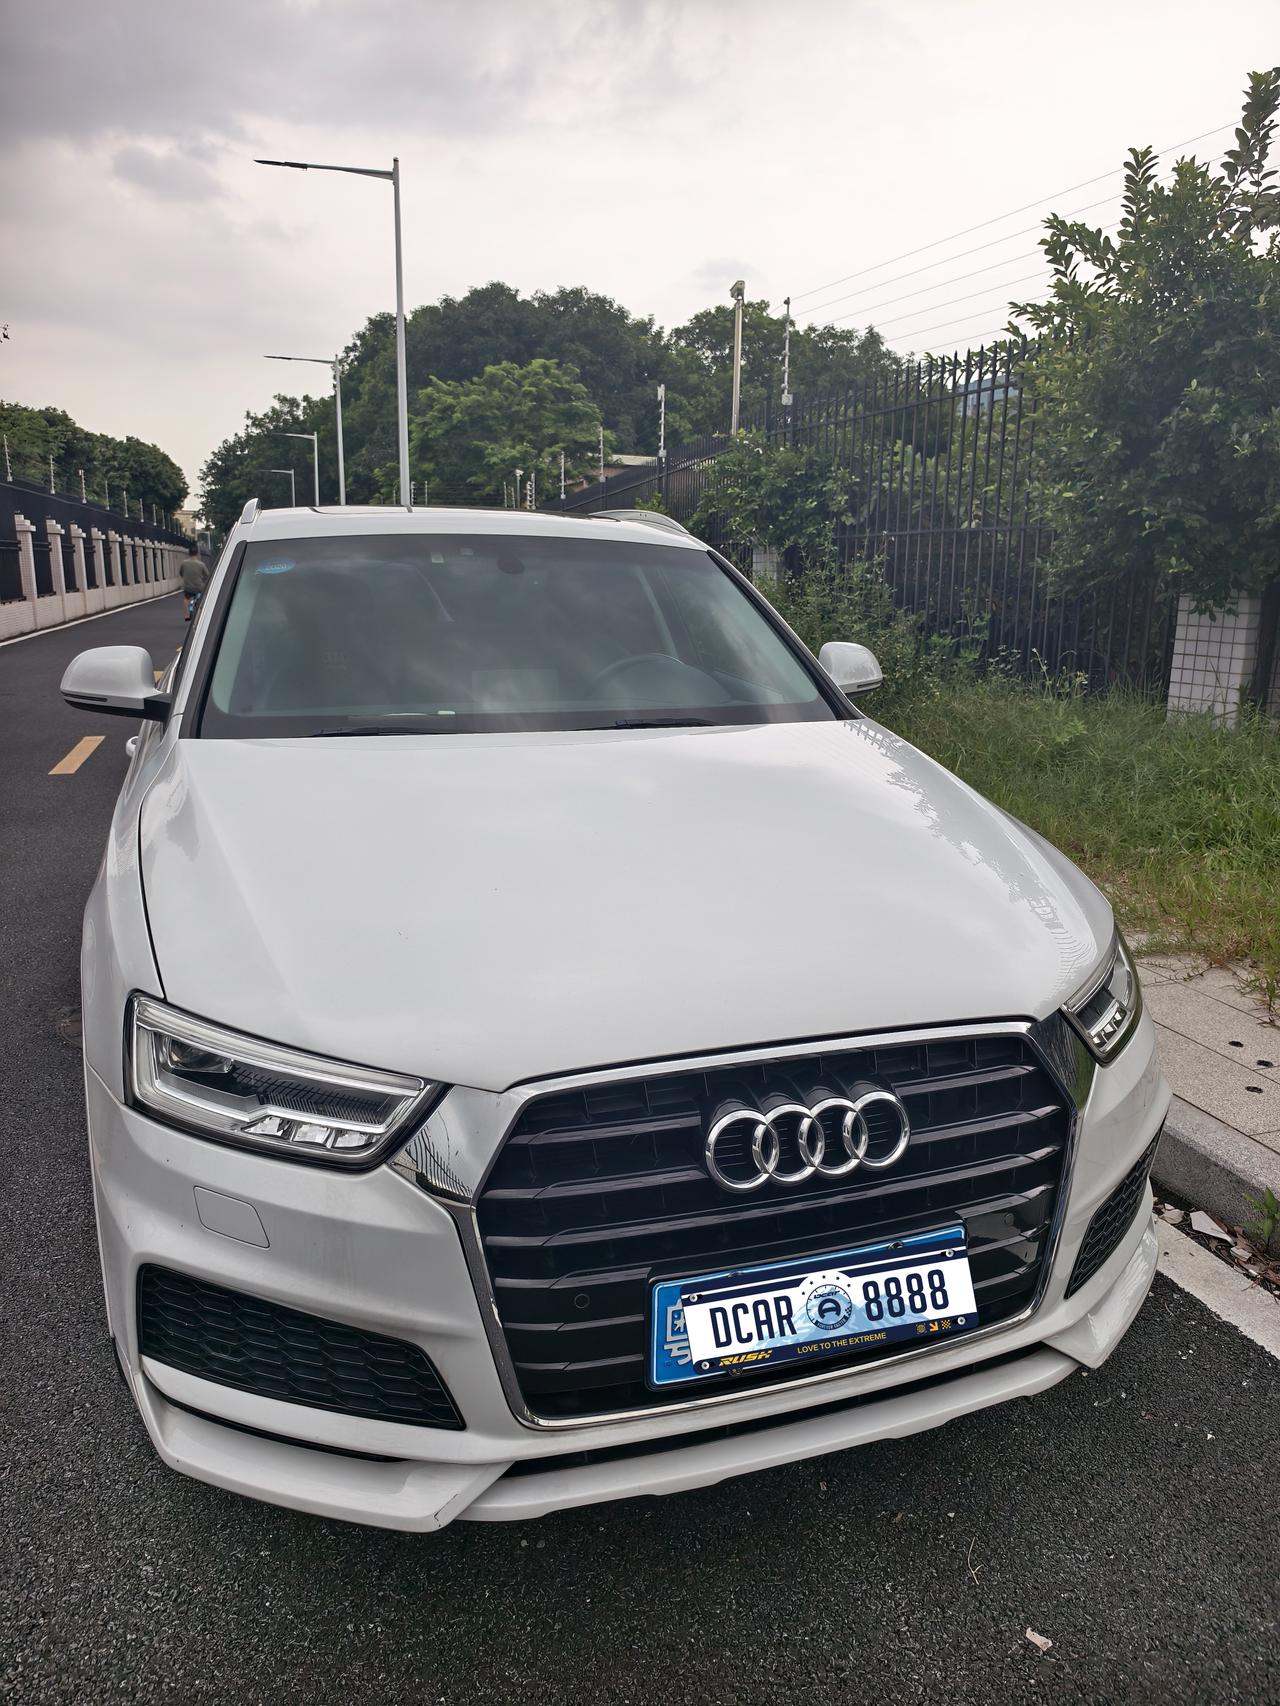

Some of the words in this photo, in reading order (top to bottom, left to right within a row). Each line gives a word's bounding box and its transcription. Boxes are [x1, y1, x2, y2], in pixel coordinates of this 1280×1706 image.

[709, 1295, 797, 1349] DCAR
[862, 1269, 949, 1321] 8888
[797, 1343, 819, 1354] LOVE
[819, 1341, 831, 1350] TO
[831, 1339, 849, 1348] THE
[848, 1332, 887, 1345] EXTREME
